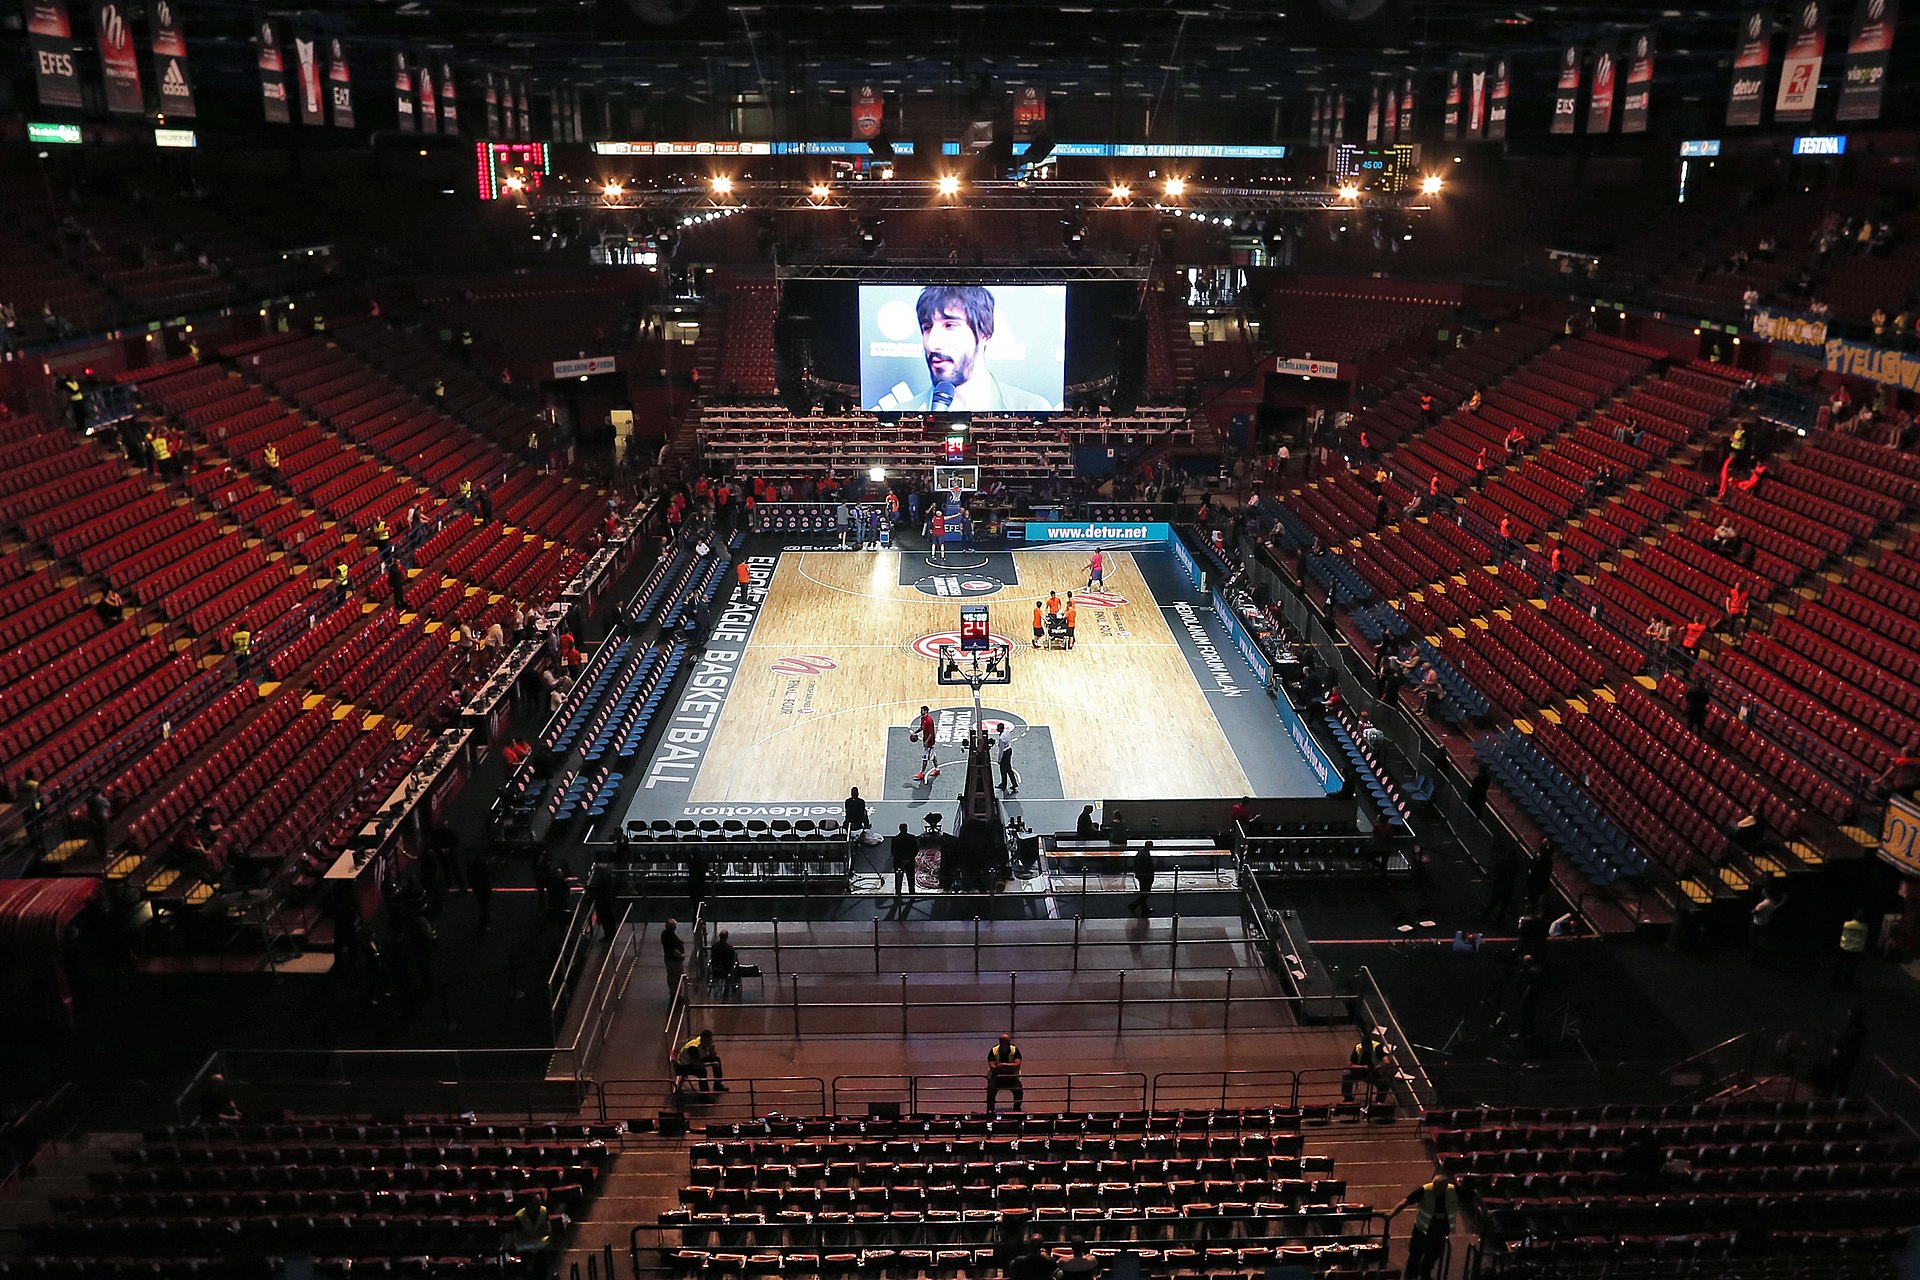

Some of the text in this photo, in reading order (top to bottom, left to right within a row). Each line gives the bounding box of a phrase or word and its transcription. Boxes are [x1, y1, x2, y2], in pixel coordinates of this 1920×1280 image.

[38, 51, 74, 77] EFES
[1733, 79, 1761, 96] detur
[1797, 136, 1839, 154] FESTINA
[555, 360, 614, 374] MEDIOLANUM FORUM
[1278, 360, 1337, 374] MEDIOLANUM FORUM
[1047, 523, 1148, 539] www.detur.net
[963, 613, 988, 622] 45:00
[963, 621, 987, 636] 24
[1173, 601, 1243, 697] MEDIOLANUM FORUM MILAN
[779, 698, 796, 716] FOUR
[645, 650, 739, 790] BASKETBALL
[935, 709, 955, 743] AIRLINES
[952, 710, 972, 743] TURKISH
[683, 806, 876, 818] #eeldevotion
